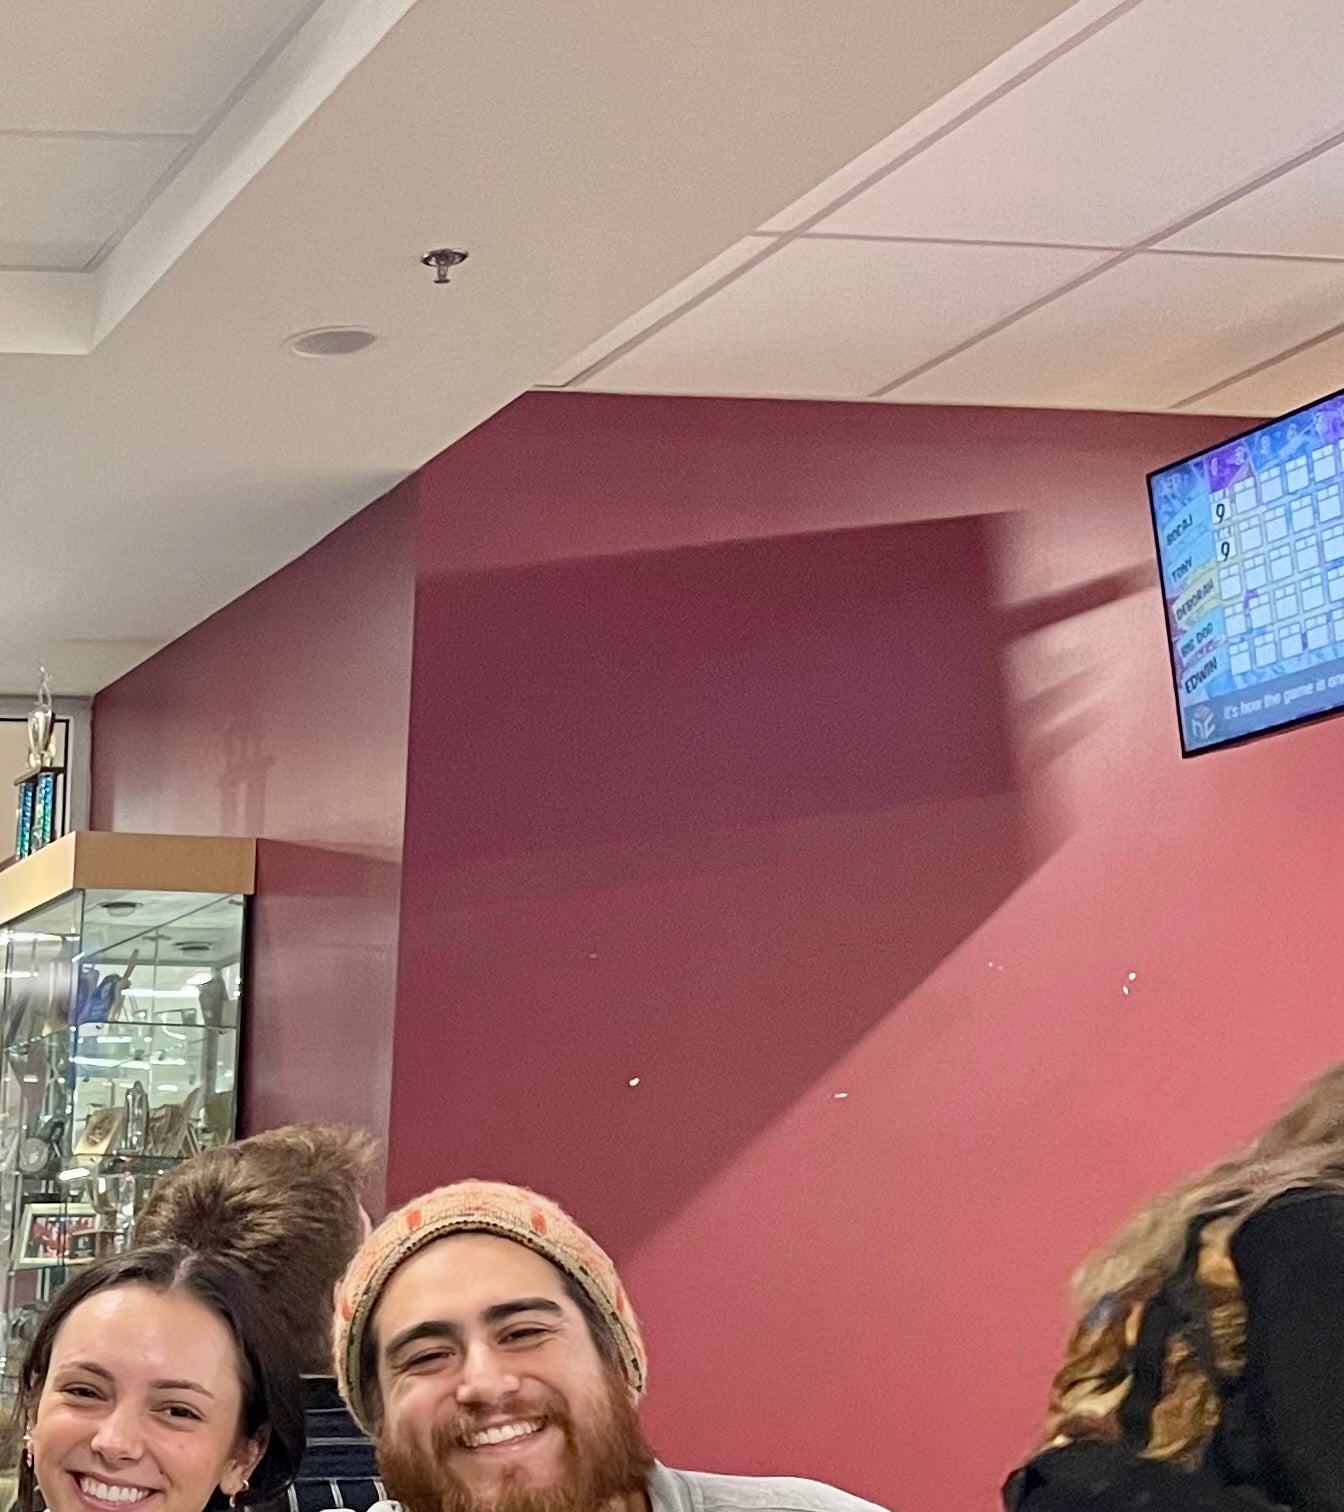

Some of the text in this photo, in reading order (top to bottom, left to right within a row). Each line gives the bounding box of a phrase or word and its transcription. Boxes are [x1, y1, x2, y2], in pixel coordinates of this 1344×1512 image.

[1215, 503, 1226, 524] 9
[1220, 541, 1231, 562] 9
[1175, 578, 1214, 621] DEBORAH
[1184, 656, 1218, 694] EDWIN
